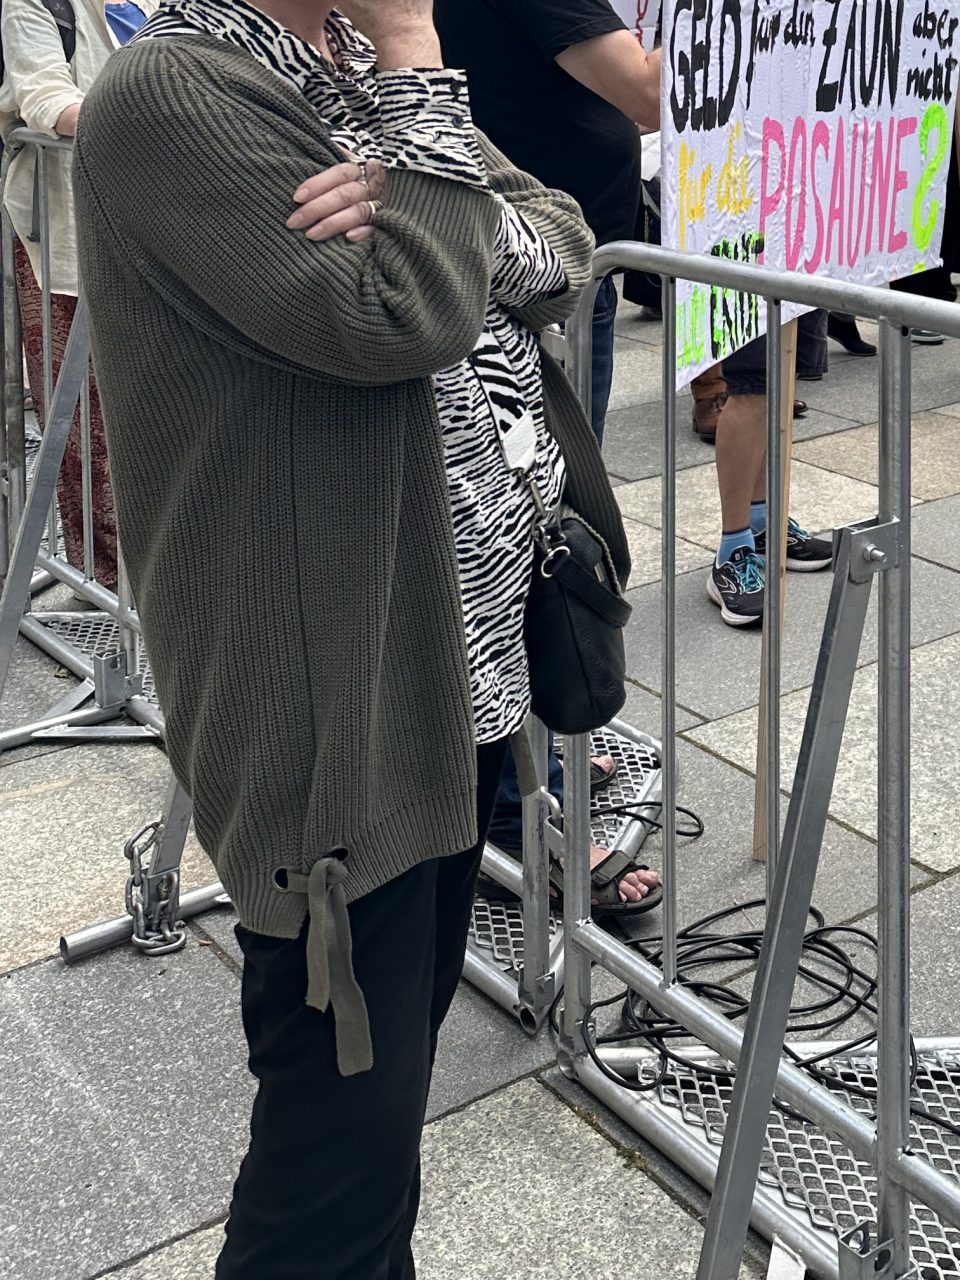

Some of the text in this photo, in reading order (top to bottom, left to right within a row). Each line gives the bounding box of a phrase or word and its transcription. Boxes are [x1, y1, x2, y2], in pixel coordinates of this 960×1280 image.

[913, 0, 959, 50] aber
[906, 49, 959, 106] nicht
[678, 141, 713, 251] für
[716, 121, 754, 216] die
